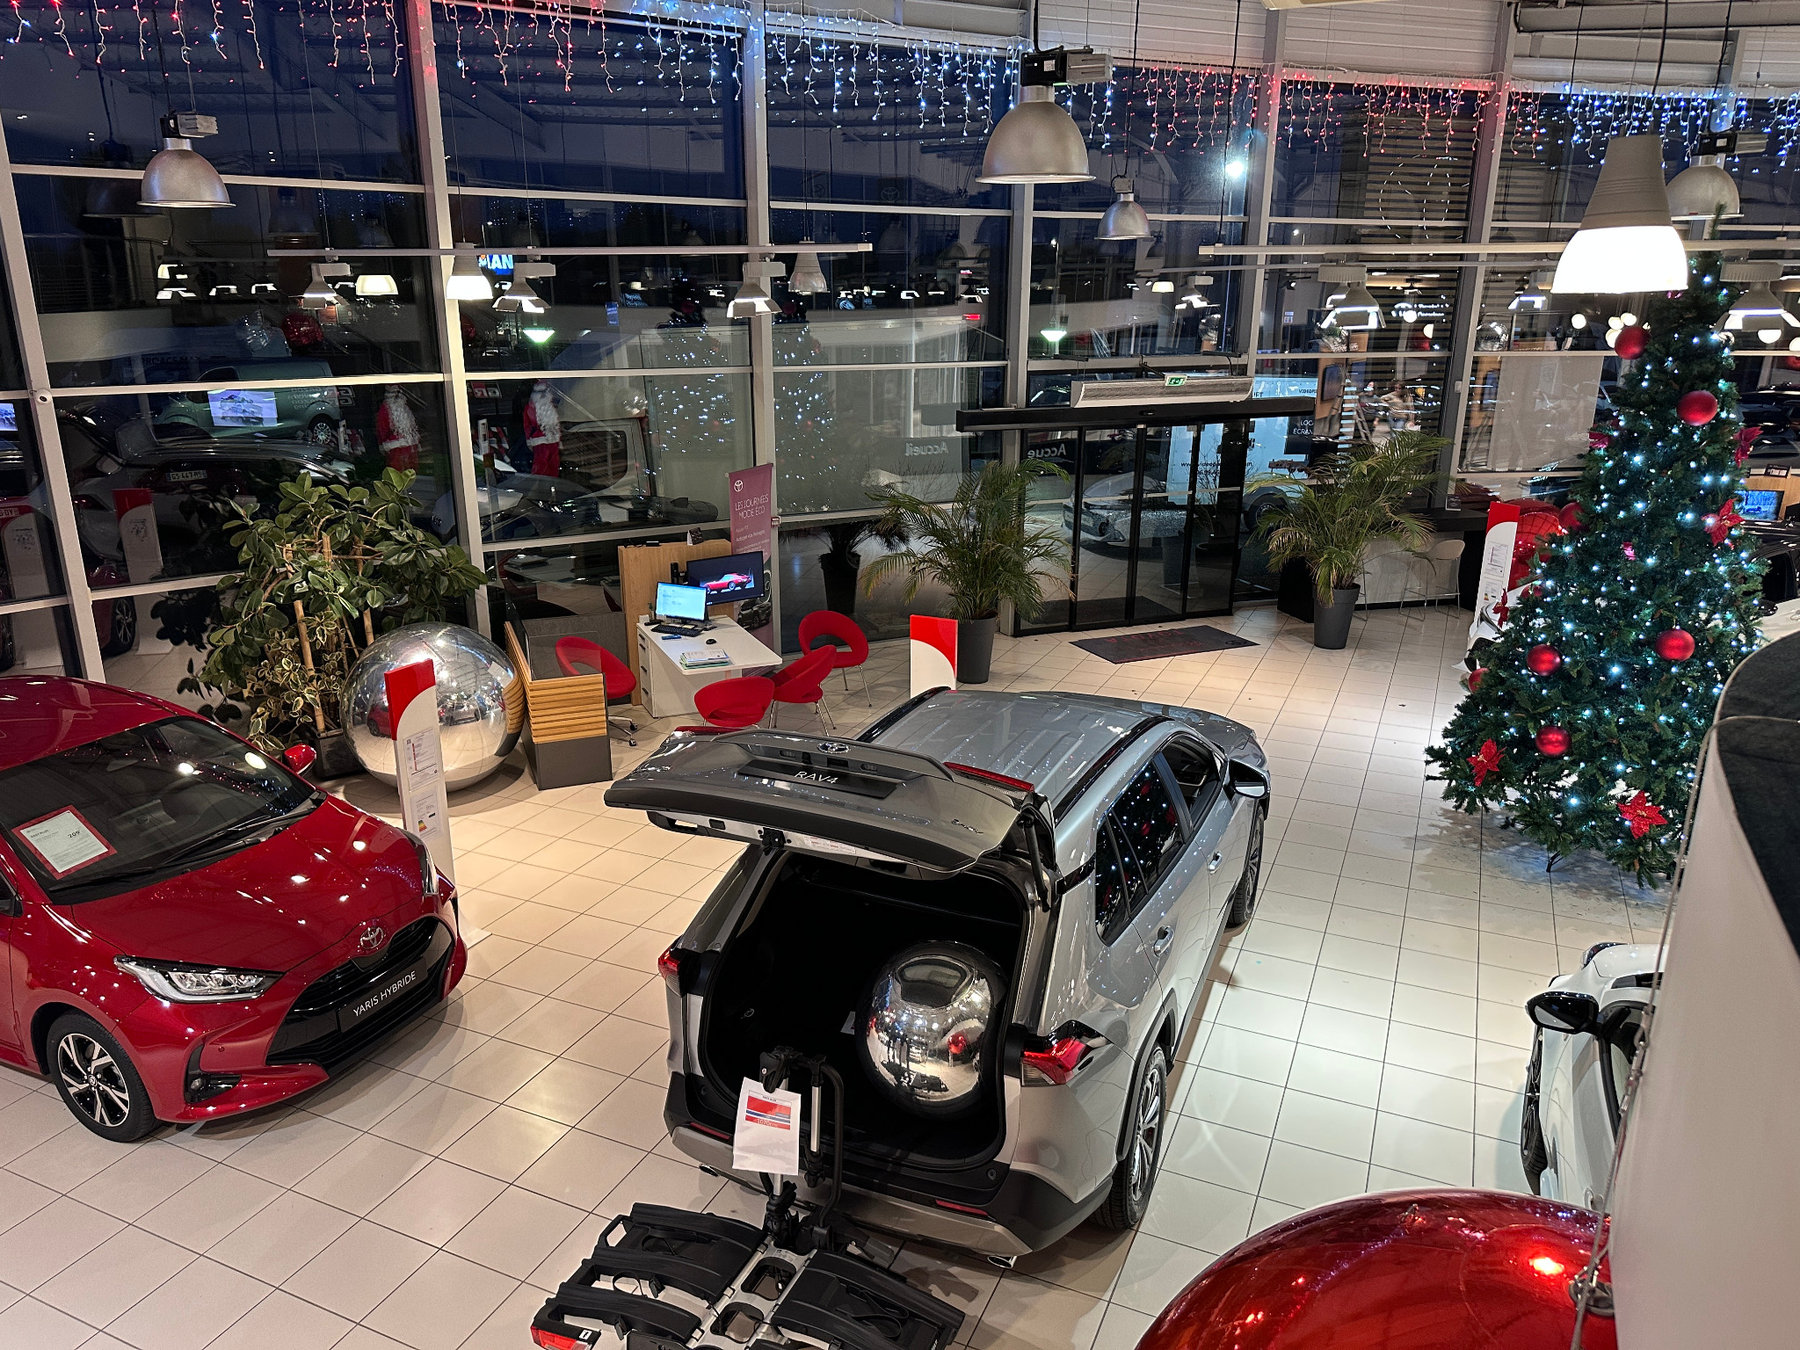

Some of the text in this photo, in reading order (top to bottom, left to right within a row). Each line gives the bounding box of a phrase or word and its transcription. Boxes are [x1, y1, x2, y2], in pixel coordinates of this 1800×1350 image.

[794, 770, 839, 784] RAV4
[352, 970, 418, 1017] YARIS HYBRIDE
